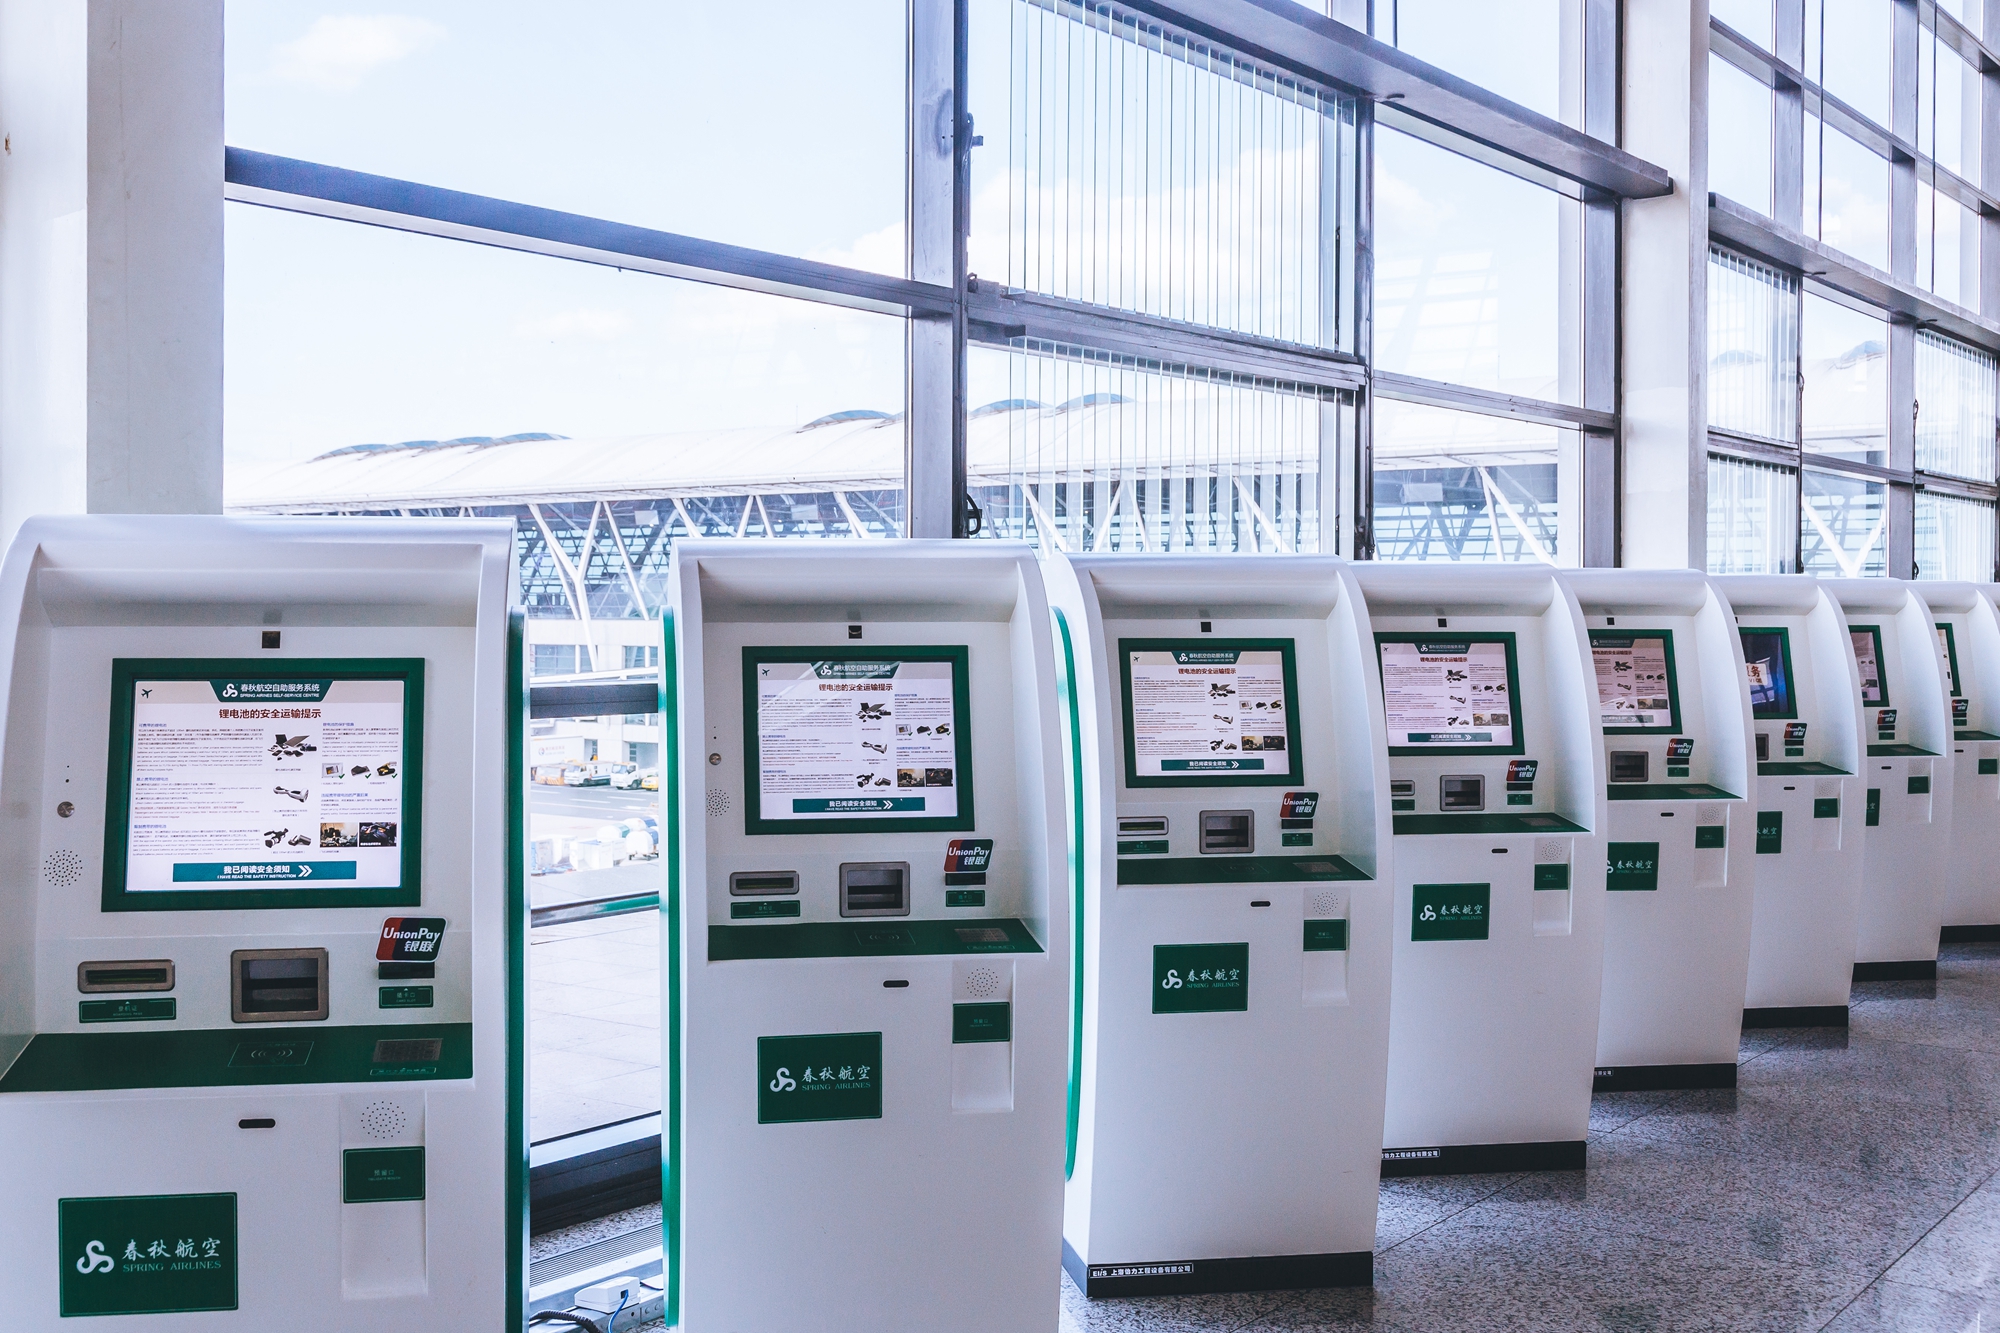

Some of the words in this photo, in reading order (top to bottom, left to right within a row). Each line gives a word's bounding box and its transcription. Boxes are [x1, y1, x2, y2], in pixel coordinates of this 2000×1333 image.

[240, 683, 320, 692] 春秋航空自助服务系统
[219, 708, 321, 718] 锂电池的安全运输提示
[1670, 742, 1692, 750] UnionPay
[1509, 765, 1536, 774] UnionPay
[1284, 798, 1316, 808] UnionPay
[948, 846, 990, 859] UnionPay
[964, 856, 985, 865] 银联
[1617, 860, 1653, 869] 春秋航空
[224, 865, 290, 874] 我已阅读安全须知
[1440, 904, 1483, 915] 春秋航空
[383, 927, 440, 944] UnionPay
[404, 941, 434, 952] 银联
[1186, 968, 1240, 982] 春秋航空
[801, 1065, 871, 1082] 春秋航空
[835, 1082, 871, 1090] AIRLINES
[122, 1237, 221, 1261] 春秋航空
[123, 1263, 164, 1272] SPRING
[170, 1260, 221, 1270] AIRLINES
